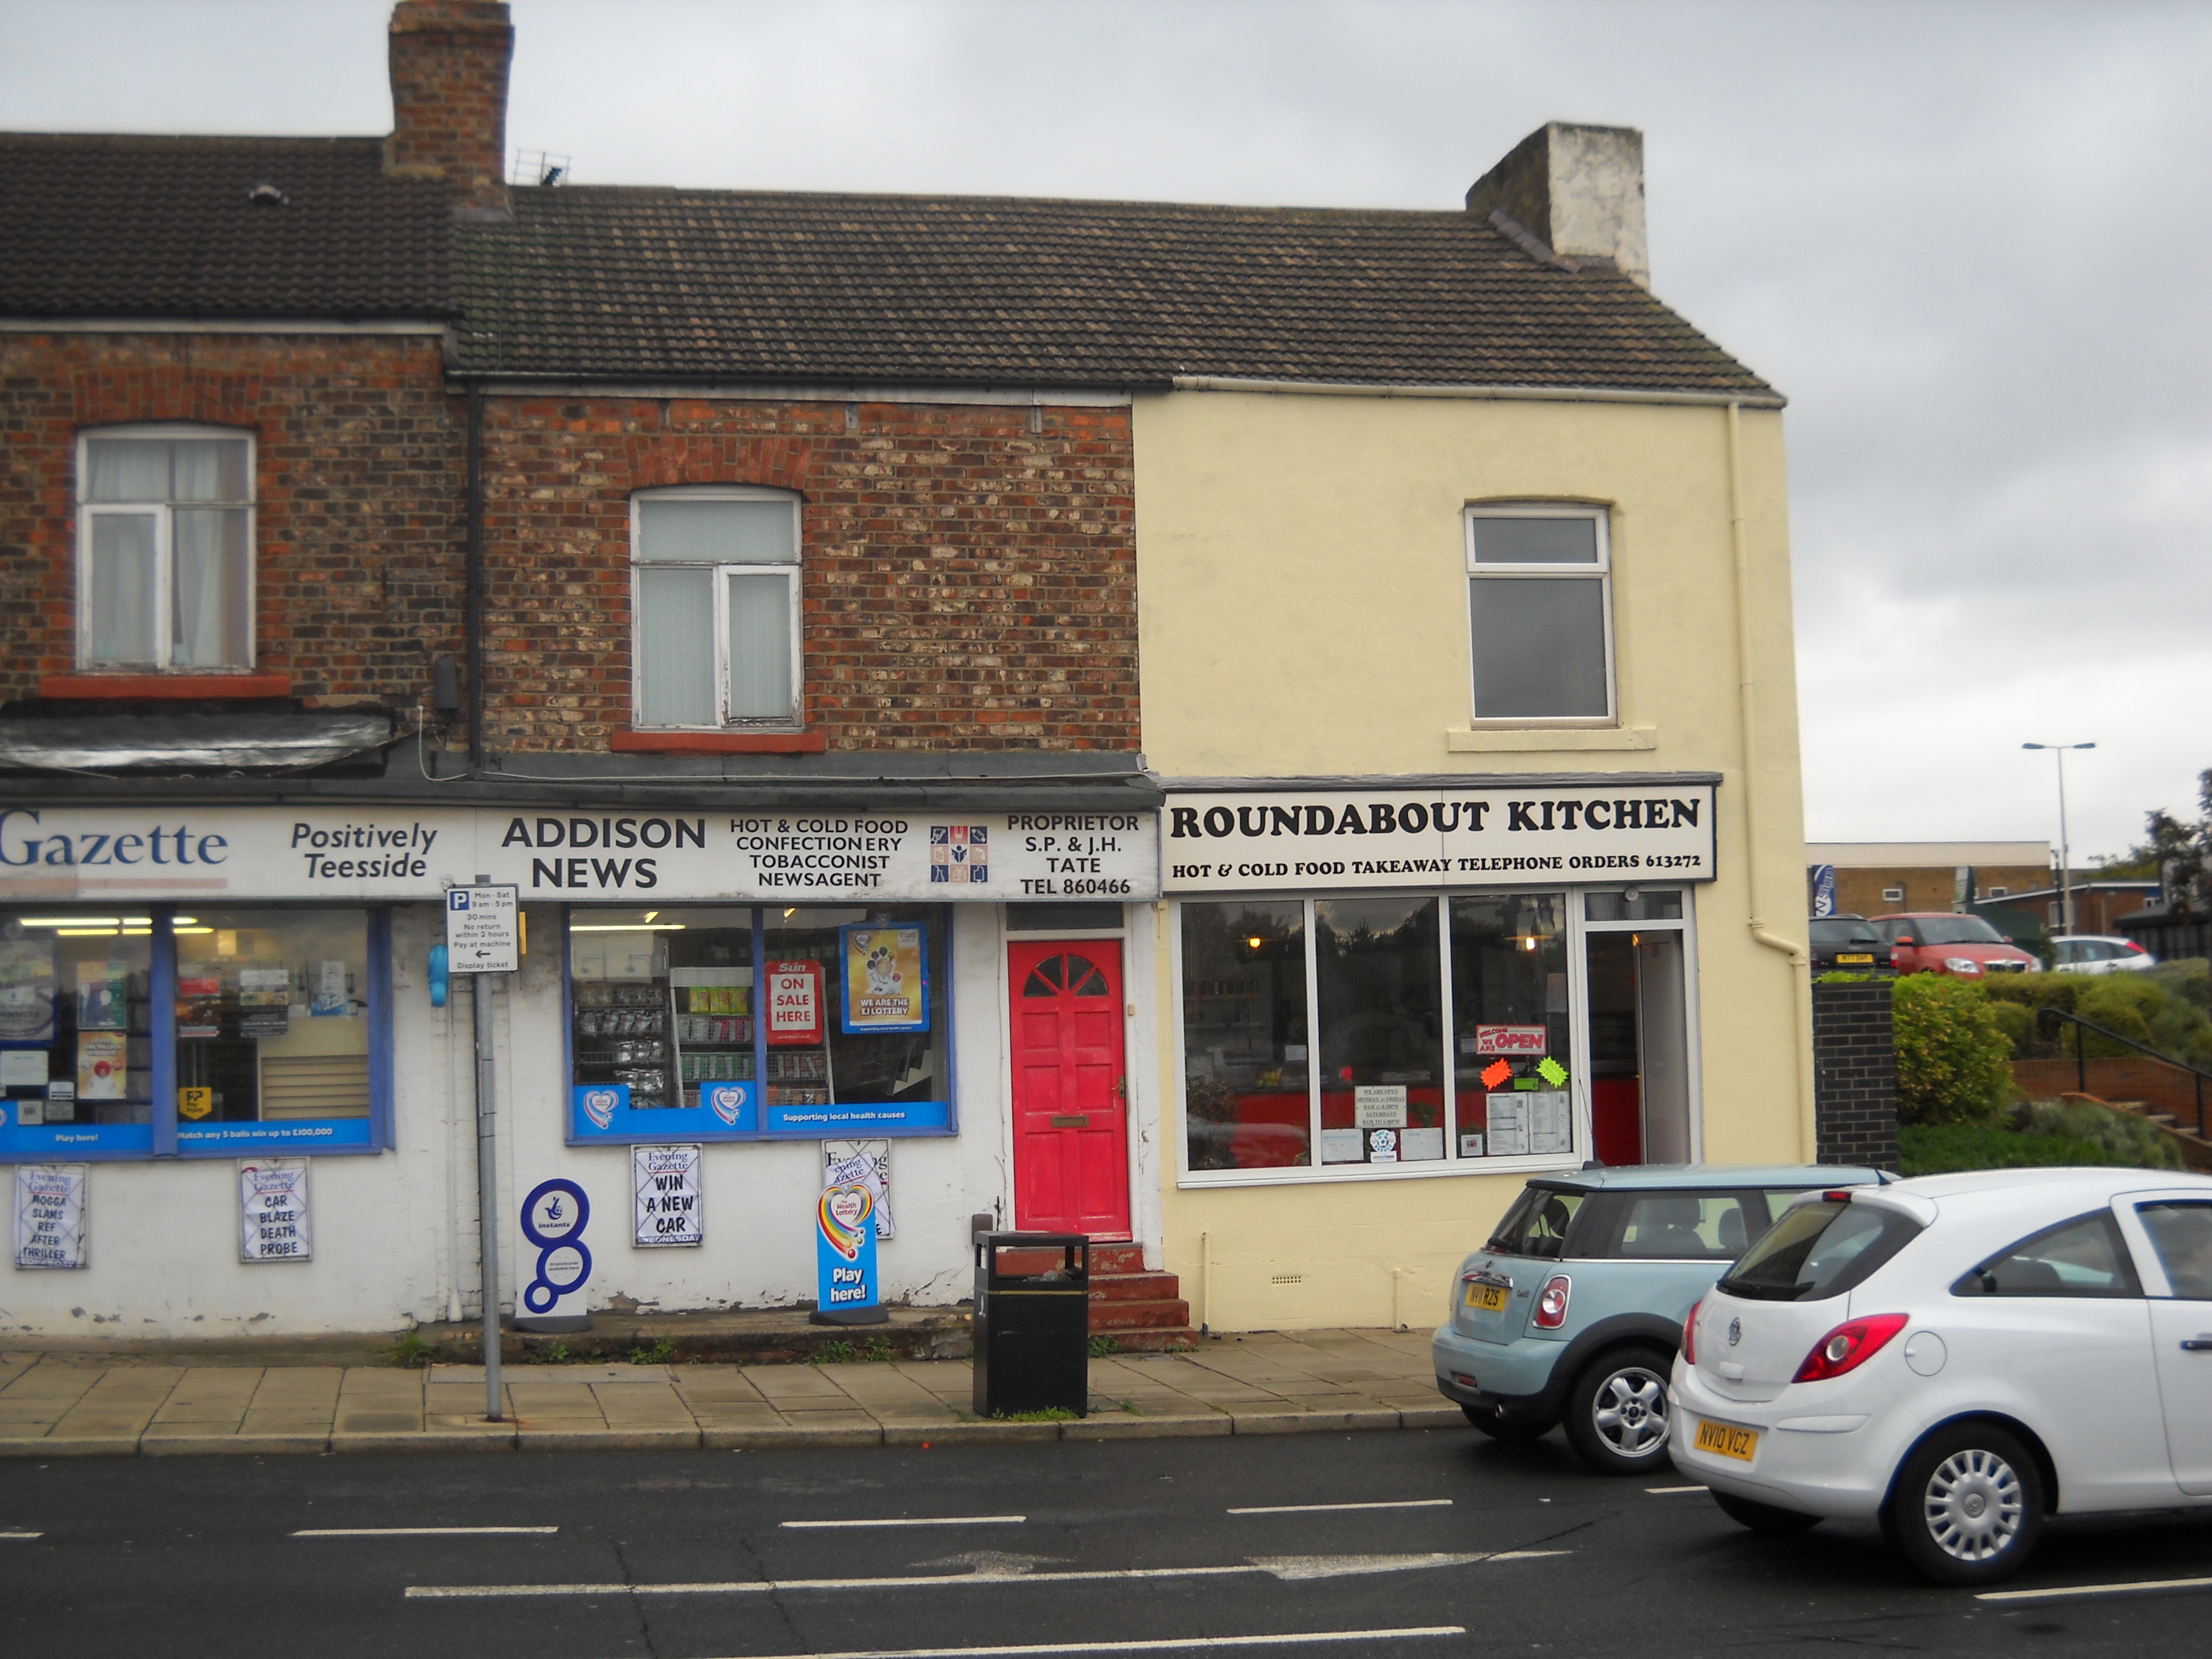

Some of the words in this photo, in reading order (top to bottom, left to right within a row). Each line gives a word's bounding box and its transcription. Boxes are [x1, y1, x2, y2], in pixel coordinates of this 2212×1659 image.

[1007, 815, 1139, 831] PROPRIETOR
[1170, 800, 1490, 838] ROUNDABOUT
[1507, 798, 1700, 831] KITCHEN
[501, 817, 706, 848] ADDISON
[730, 819, 771, 833] HOT
[777, 819, 790, 834] &
[796, 819, 848, 834] COLD
[854, 820, 908, 834] FOOD
[0, 809, 228, 866] Gazette
[291, 822, 438, 855] Positively
[736, 837, 902, 851] CONFECTIONERY
[1025, 837, 1061, 852] S.P.
[1068, 837, 1082, 852] &
[1087, 836, 1122, 855] J.H.
[304, 852, 427, 879] Teesside
[749, 854, 890, 869] TOBACCONIST
[1047, 857, 1101, 873] TATE
[1172, 864, 1212, 878] HOT
[1218, 864, 1233, 877] &
[1238, 862, 1288, 877] COLD
[1295, 861, 1346, 876] FOOD
[1352, 858, 1452, 874] TAKEAWAY
[1458, 856, 1563, 871] TELEPHONE
[1569, 855, 1639, 868] ORDERS
[1646, 855, 1701, 868] 613272
[532, 857, 658, 888] NEWS
[758, 872, 882, 886] NEWSAGENT
[1021, 879, 1059, 894] TEL
[1063, 879, 1131, 894] 860466
[454, 893, 468, 910] P
[457, 961, 484, 970] Display
[779, 963, 806, 973] Sun
[781, 979, 804, 990] ON
[777, 994, 809, 1006] SALE
[893, 998, 909, 1007] THE
[776, 1011, 810, 1022] HERE
[861, 1007, 870, 1016] £1
[871, 1007, 908, 1016] LOTTERY
[1480, 1028, 1508, 1039] WELCOME
[1495, 1033, 1543, 1048] OPEN
[783, 1113, 828, 1122] Supporting
[850, 1111, 876, 1119] health
[56, 1133, 75, 1142] Play
[76, 1133, 99, 1142] here!
[649, 1152, 688, 1161] Evening
[648, 1162, 688, 1171] Gazette
[31, 1172, 72, 1185] Evening
[255, 1171, 294, 1182] Evening
[655, 1175, 683, 1191] WIN
[29, 1182, 71, 1193] Gazette
[255, 1182, 295, 1191] Gazette
[32, 1195, 66, 1207] MOGGA
[265, 1195, 287, 1207] CAR
[646, 1197, 656, 1213] A
[662, 1196, 693, 1213] NEW
[33, 1208, 64, 1220] SLAMS
[260, 1211, 295, 1223] BLAZE
[38, 1222, 56, 1232] REF
[656, 1217, 686, 1233] CAR
[261, 1225, 296, 1239] DEATH
[31, 1233, 59, 1245] AFTER
[642, 1235, 700, 1244] WEDNESDAY
[23, 1247, 66, 1259] THRILLER
[261, 1242, 298, 1255] PROBE
[833, 1267, 863, 1284] Play
[831, 1284, 866, 1302] here!
[1483, 1287, 1500, 1306] RZS
[1700, 1423, 1726, 1449] NV10
[1728, 1429, 1750, 1455] VCZ
